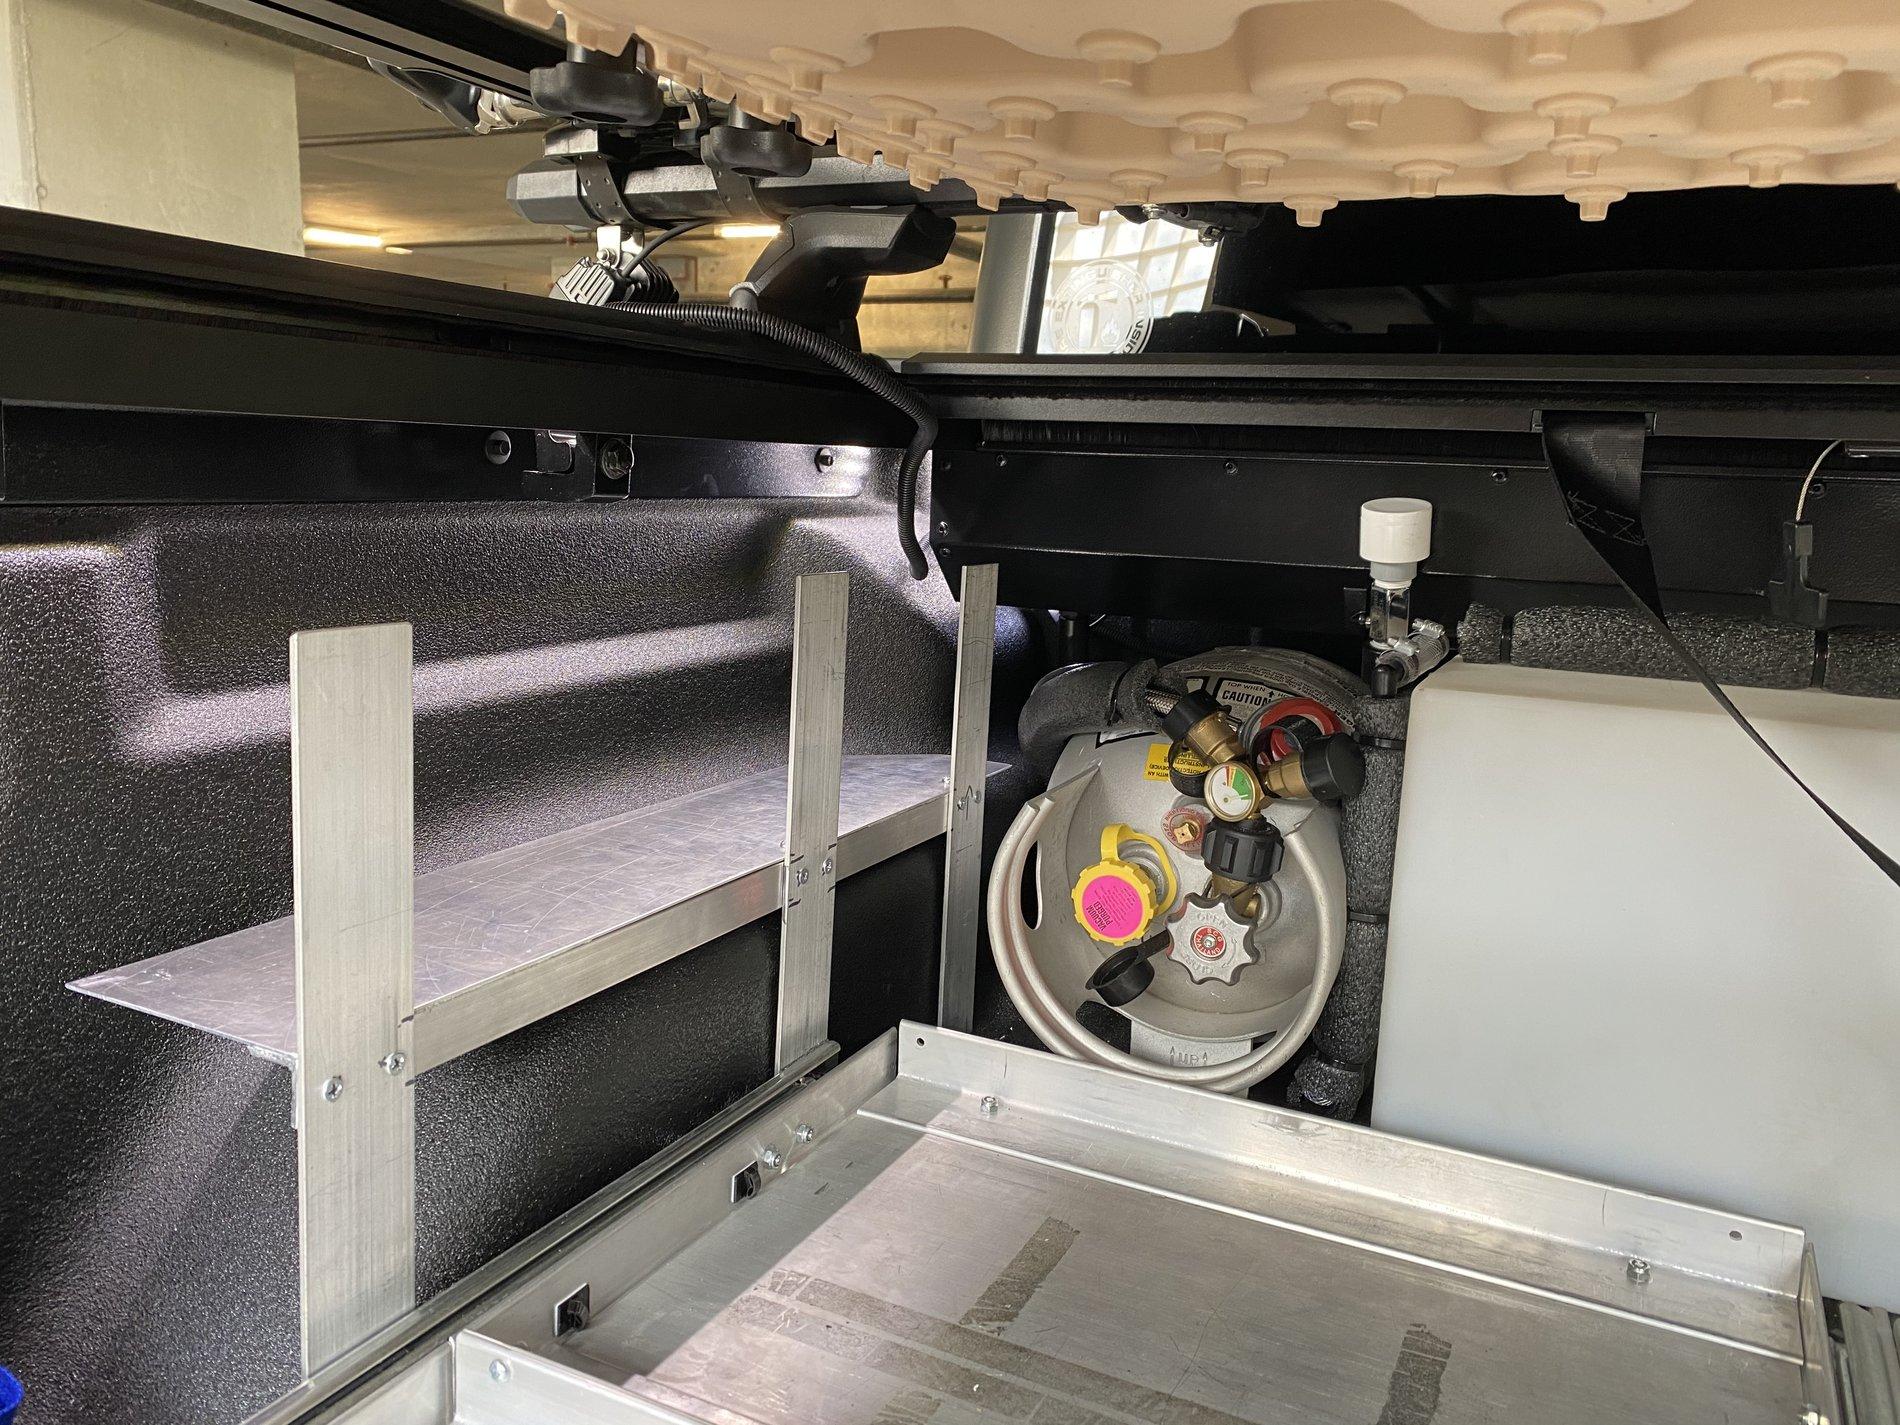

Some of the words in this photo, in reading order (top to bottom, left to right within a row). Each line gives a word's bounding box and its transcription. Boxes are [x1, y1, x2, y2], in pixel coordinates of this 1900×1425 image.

[1243, 684, 1266, 692] WHEN
[1222, 690, 1272, 707] CAUTION
[1086, 904, 1107, 931] VACUUM
[1093, 901, 1114, 926] PURGED
[1197, 912, 1228, 928] OPEN
[1195, 934, 1221, 956] THAILAND
[1178, 1052, 1200, 1067] UP
